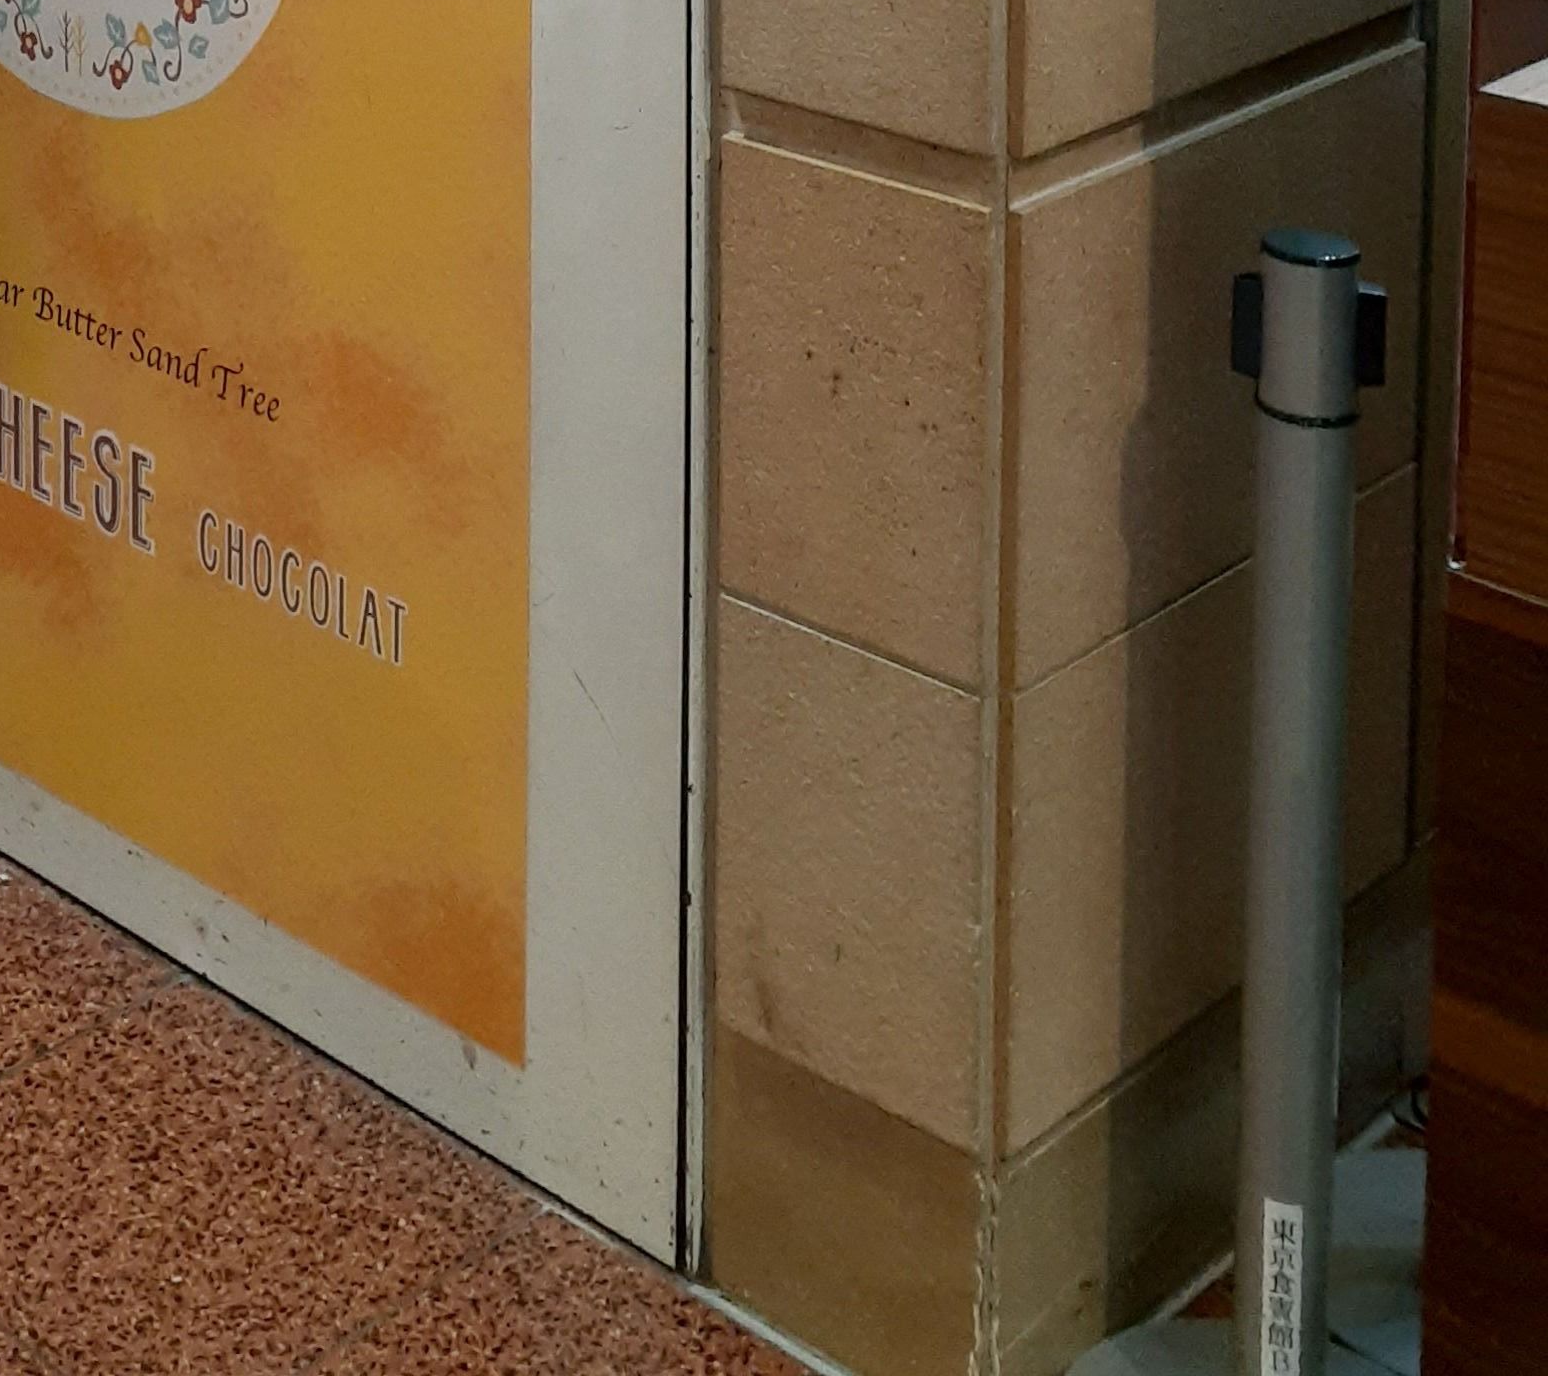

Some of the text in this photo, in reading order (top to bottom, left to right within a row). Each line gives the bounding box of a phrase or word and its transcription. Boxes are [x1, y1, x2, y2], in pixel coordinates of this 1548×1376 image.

[33, 286, 123, 350] Butter
[129, 328, 208, 389] Sand
[211, 361, 281, 423] Tree
[198, 509, 410, 665] CHOCOLAT
